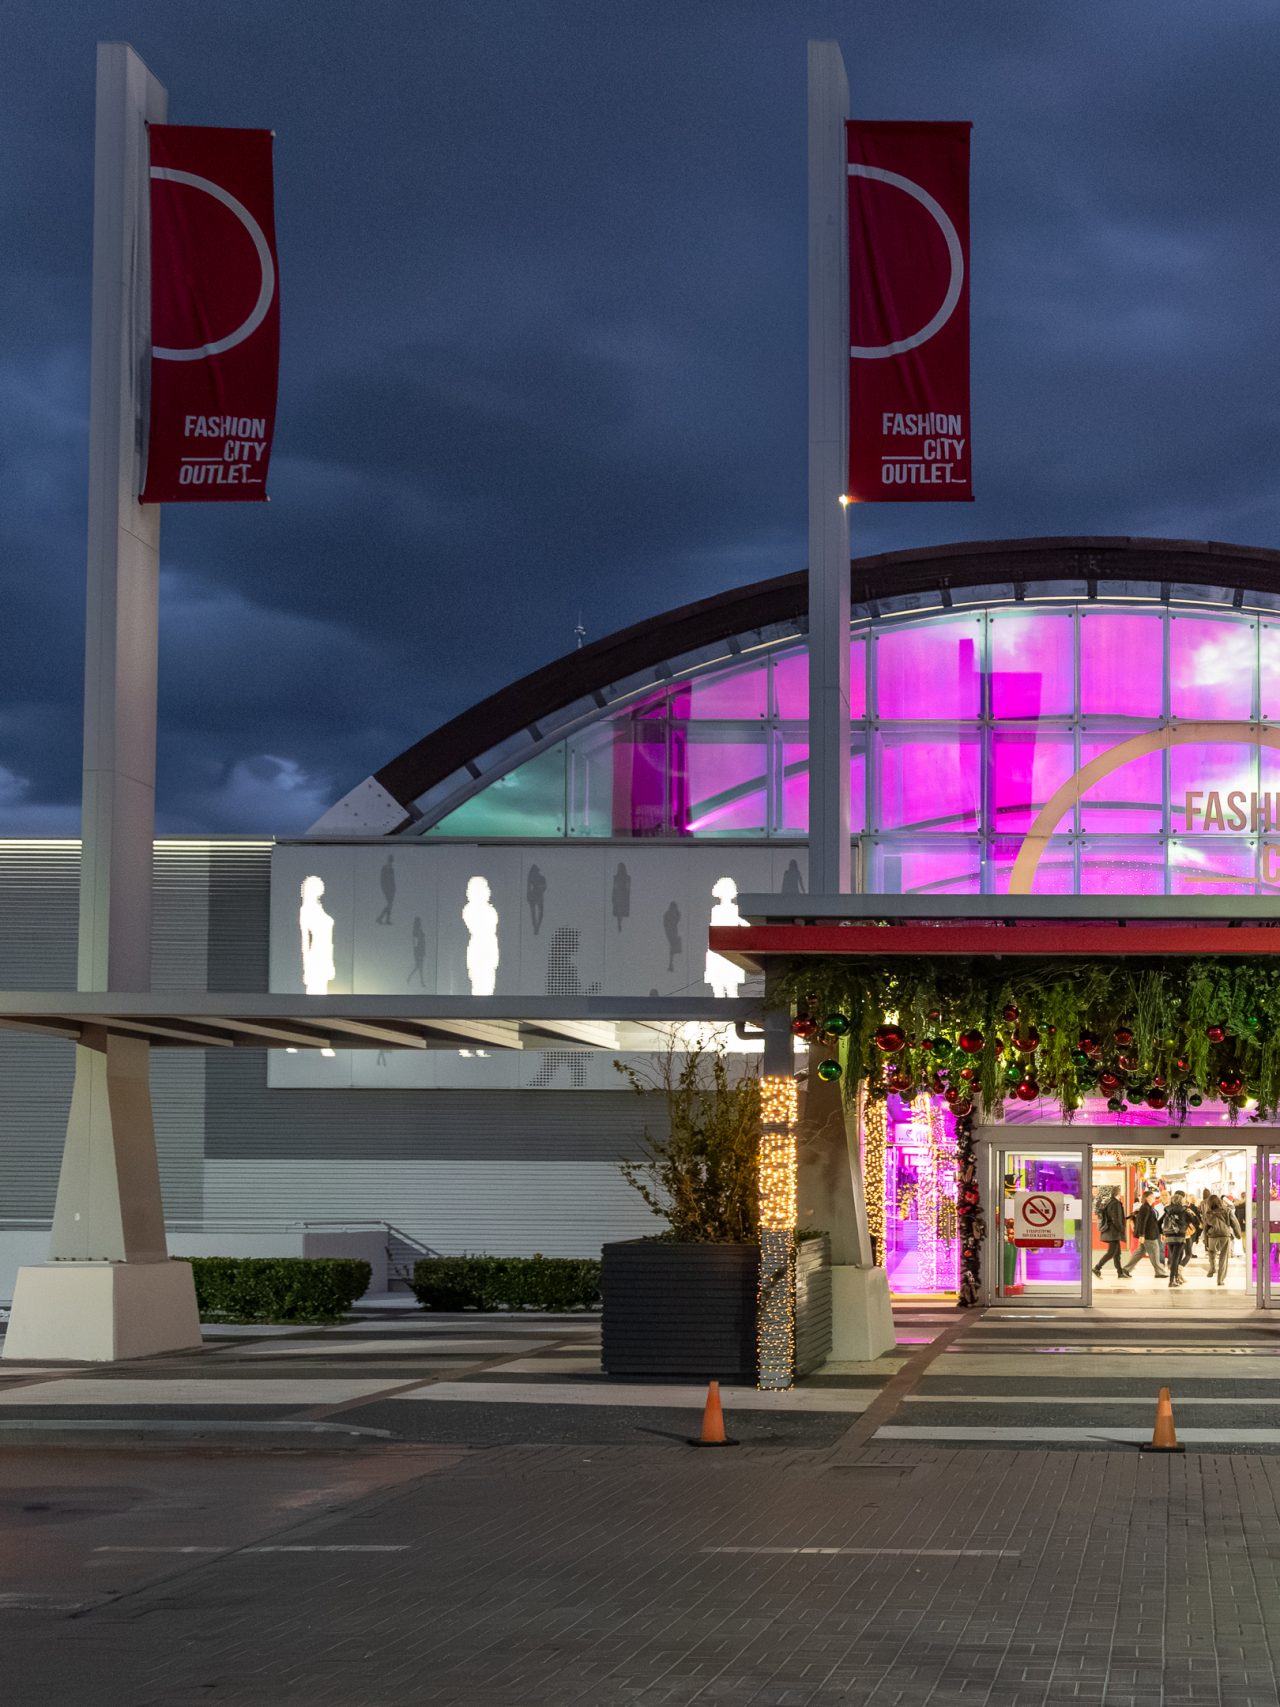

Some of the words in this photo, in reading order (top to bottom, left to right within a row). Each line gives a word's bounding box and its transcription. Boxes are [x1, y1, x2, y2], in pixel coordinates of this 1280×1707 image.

[184, 415, 266, 439] FASHION
[882, 411, 962, 436] FASHION
[223, 440, 267, 462] CITY
[923, 438, 966, 460] CITY
[178, 463, 251, 485] OUTLET
[881, 462, 954, 484] OUTLET
